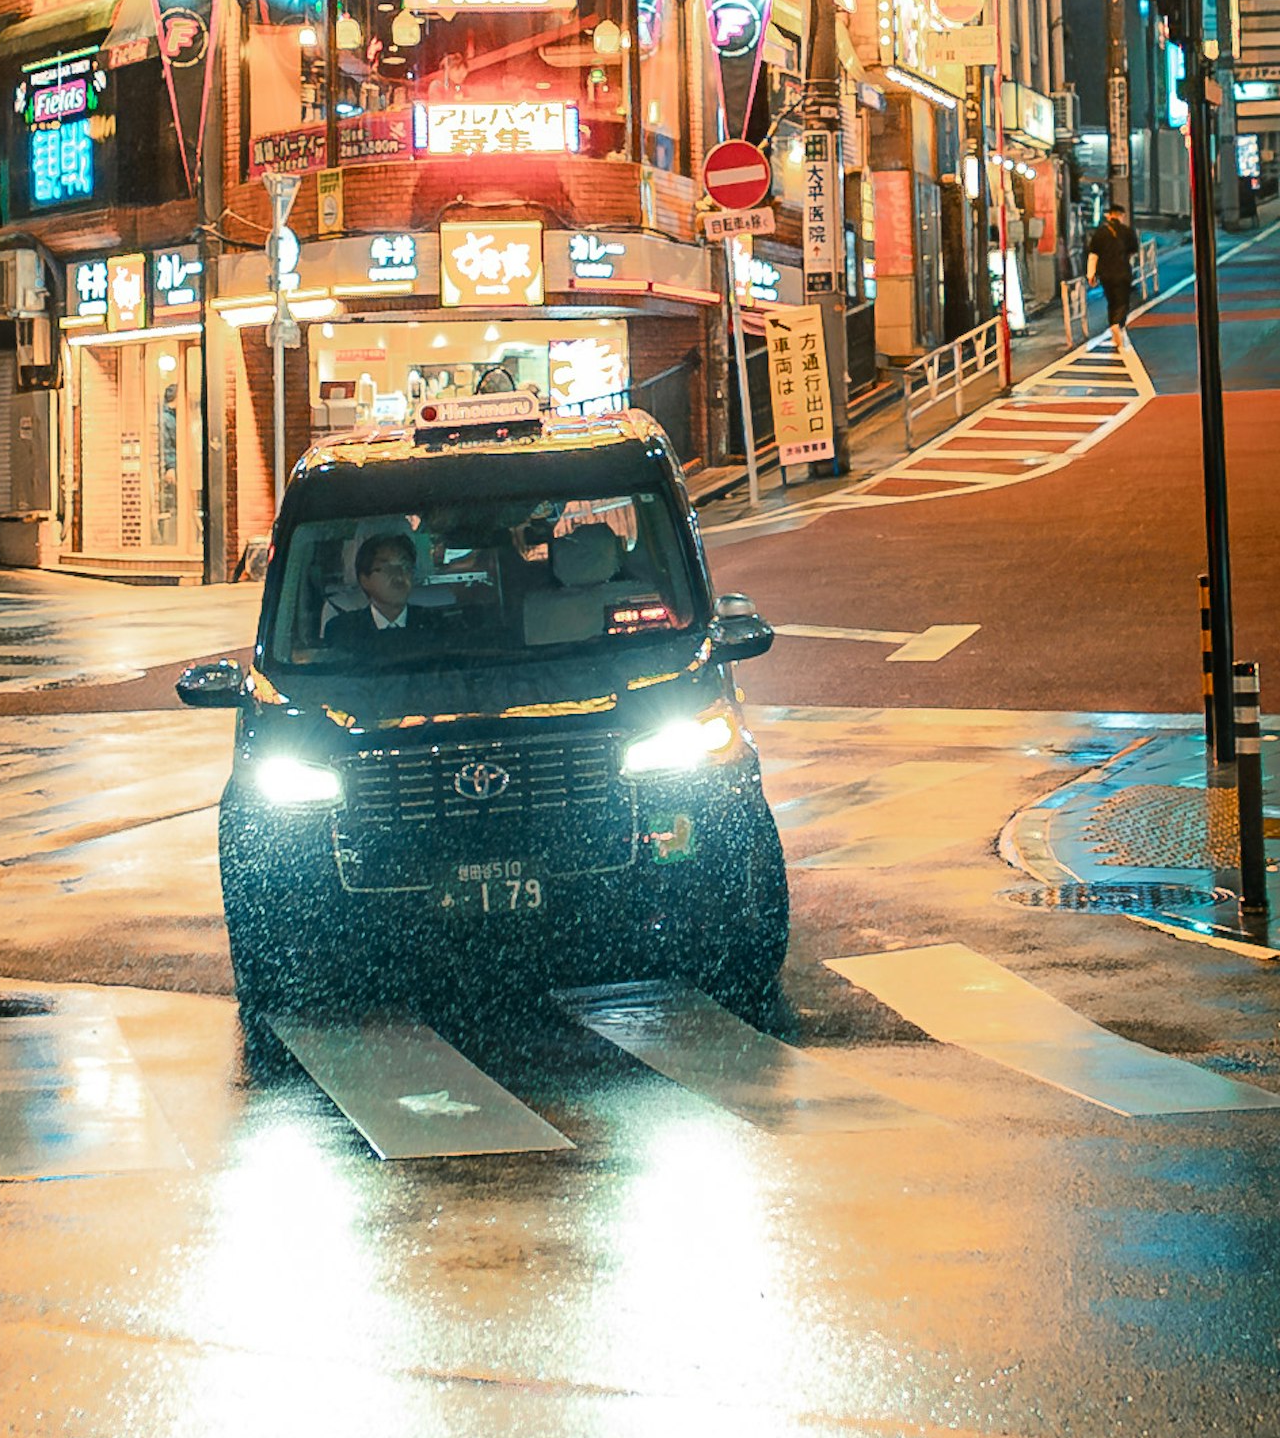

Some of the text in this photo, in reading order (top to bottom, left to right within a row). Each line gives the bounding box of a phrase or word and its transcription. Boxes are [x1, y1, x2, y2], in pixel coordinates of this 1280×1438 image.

[35, 87, 85, 119] Fields
[431, 103, 560, 126] アルバイト
[569, 233, 626, 262] カレー
[772, 337, 799, 433] 車両は左へ
[796, 317, 824, 433] 一方通行出口
[439, 401, 531, 421] Hinomaru
